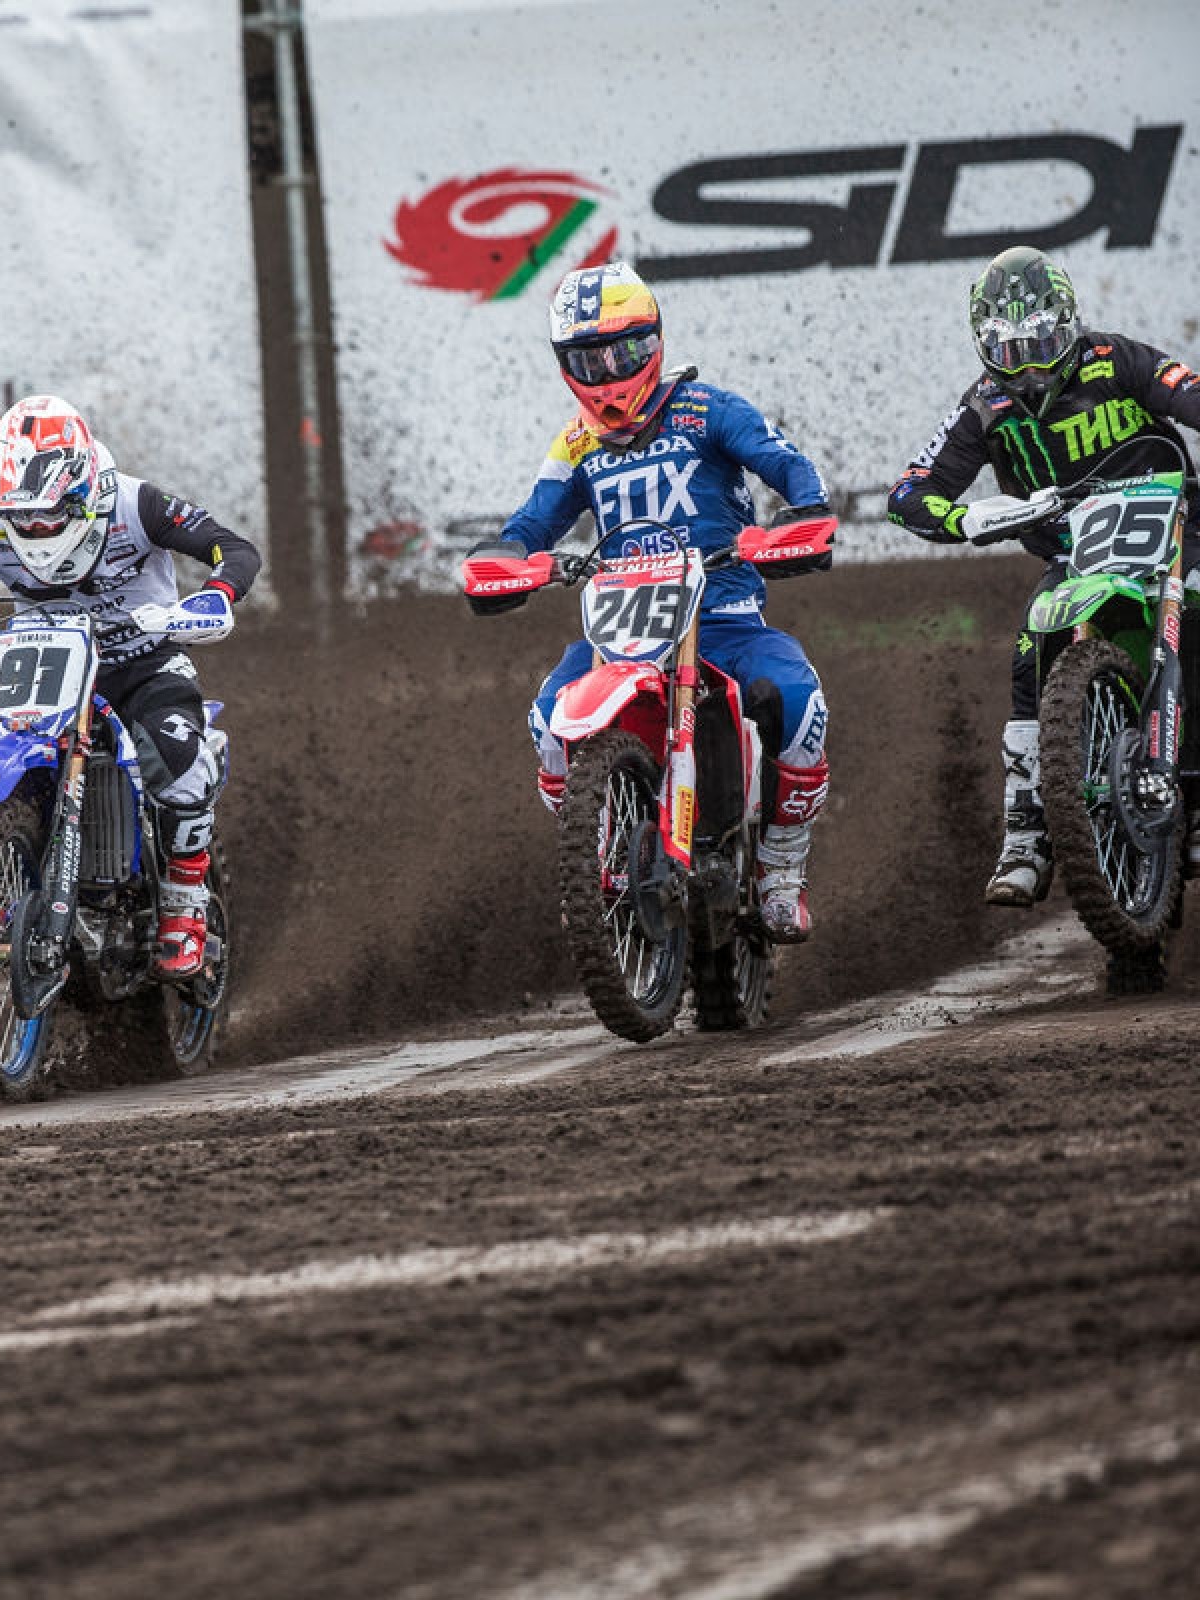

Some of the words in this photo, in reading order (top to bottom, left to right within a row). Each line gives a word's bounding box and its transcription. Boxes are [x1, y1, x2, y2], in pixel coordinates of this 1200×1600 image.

[630, 123, 1184, 284] SIDI
[593, 459, 702, 540] FOX
[753, 545, 815, 560] ACERBIS
[1074, 500, 1174, 573] 25
[472, 577, 533, 593] ACERBIS
[592, 585, 692, 642] 243
[166, 620, 225, 631] ACERBIS
